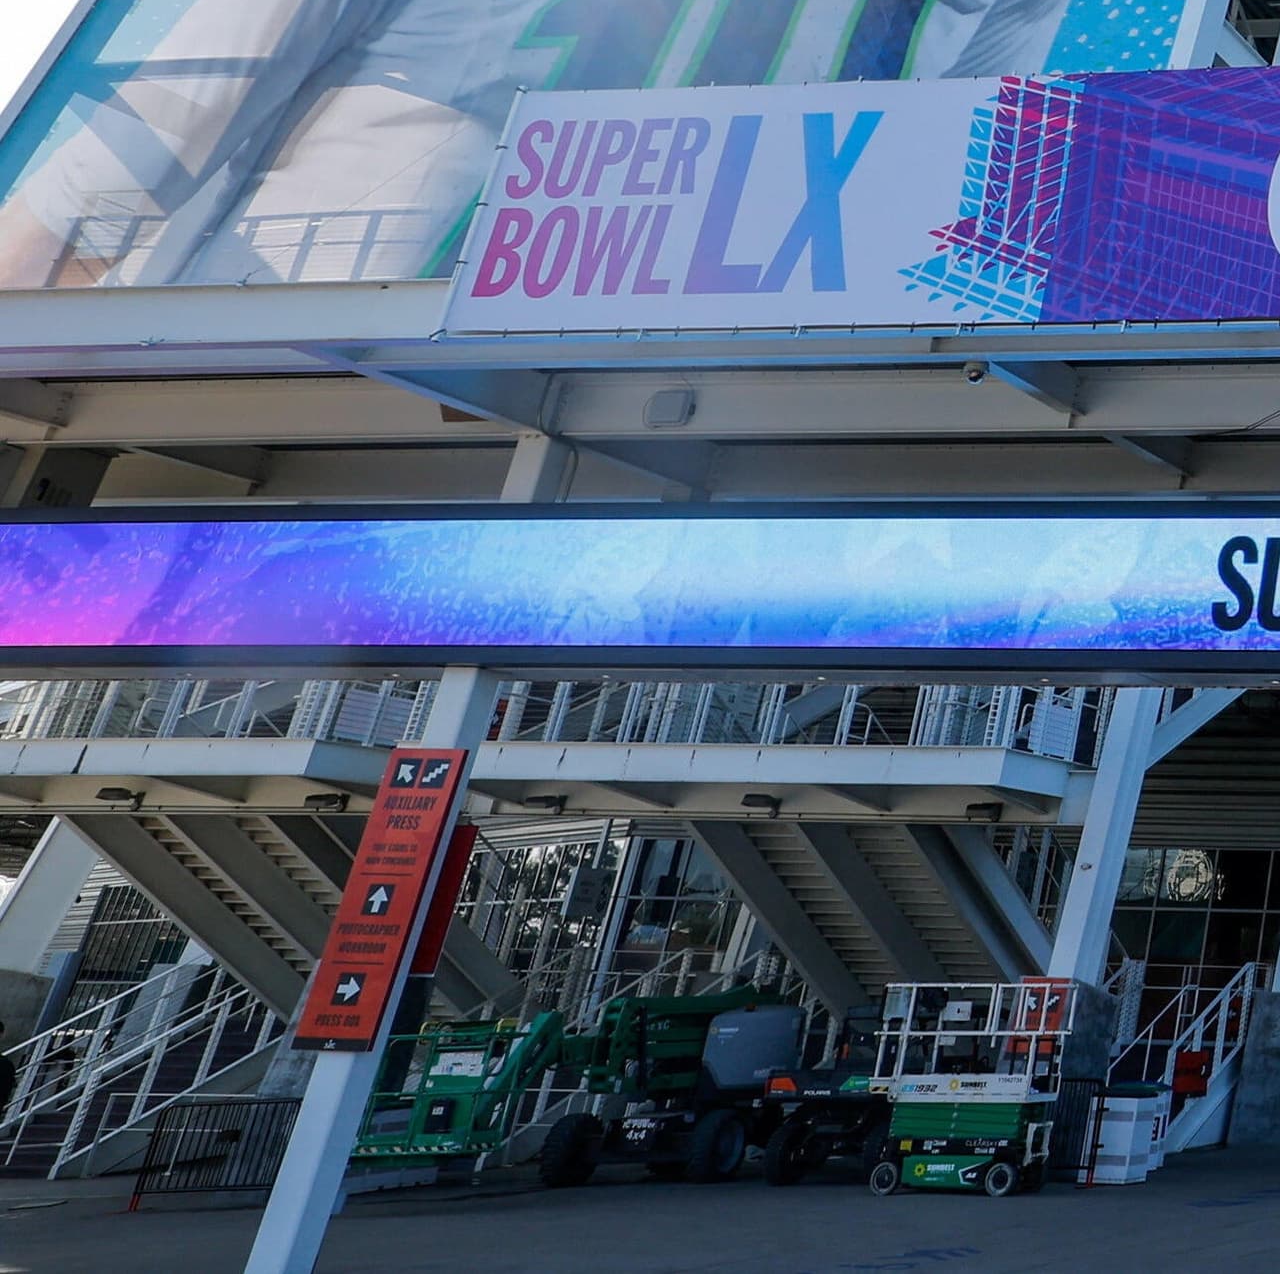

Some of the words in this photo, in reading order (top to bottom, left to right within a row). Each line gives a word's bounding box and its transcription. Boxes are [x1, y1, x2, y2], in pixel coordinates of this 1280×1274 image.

[505, 116, 712, 200] SUPER
[682, 110, 886, 295] LX
[470, 204, 674, 299] BOWL
[384, 795, 437, 811] AUXILIARY
[386, 814, 422, 831] PRESS
[315, 1013, 342, 1027] PRESS
